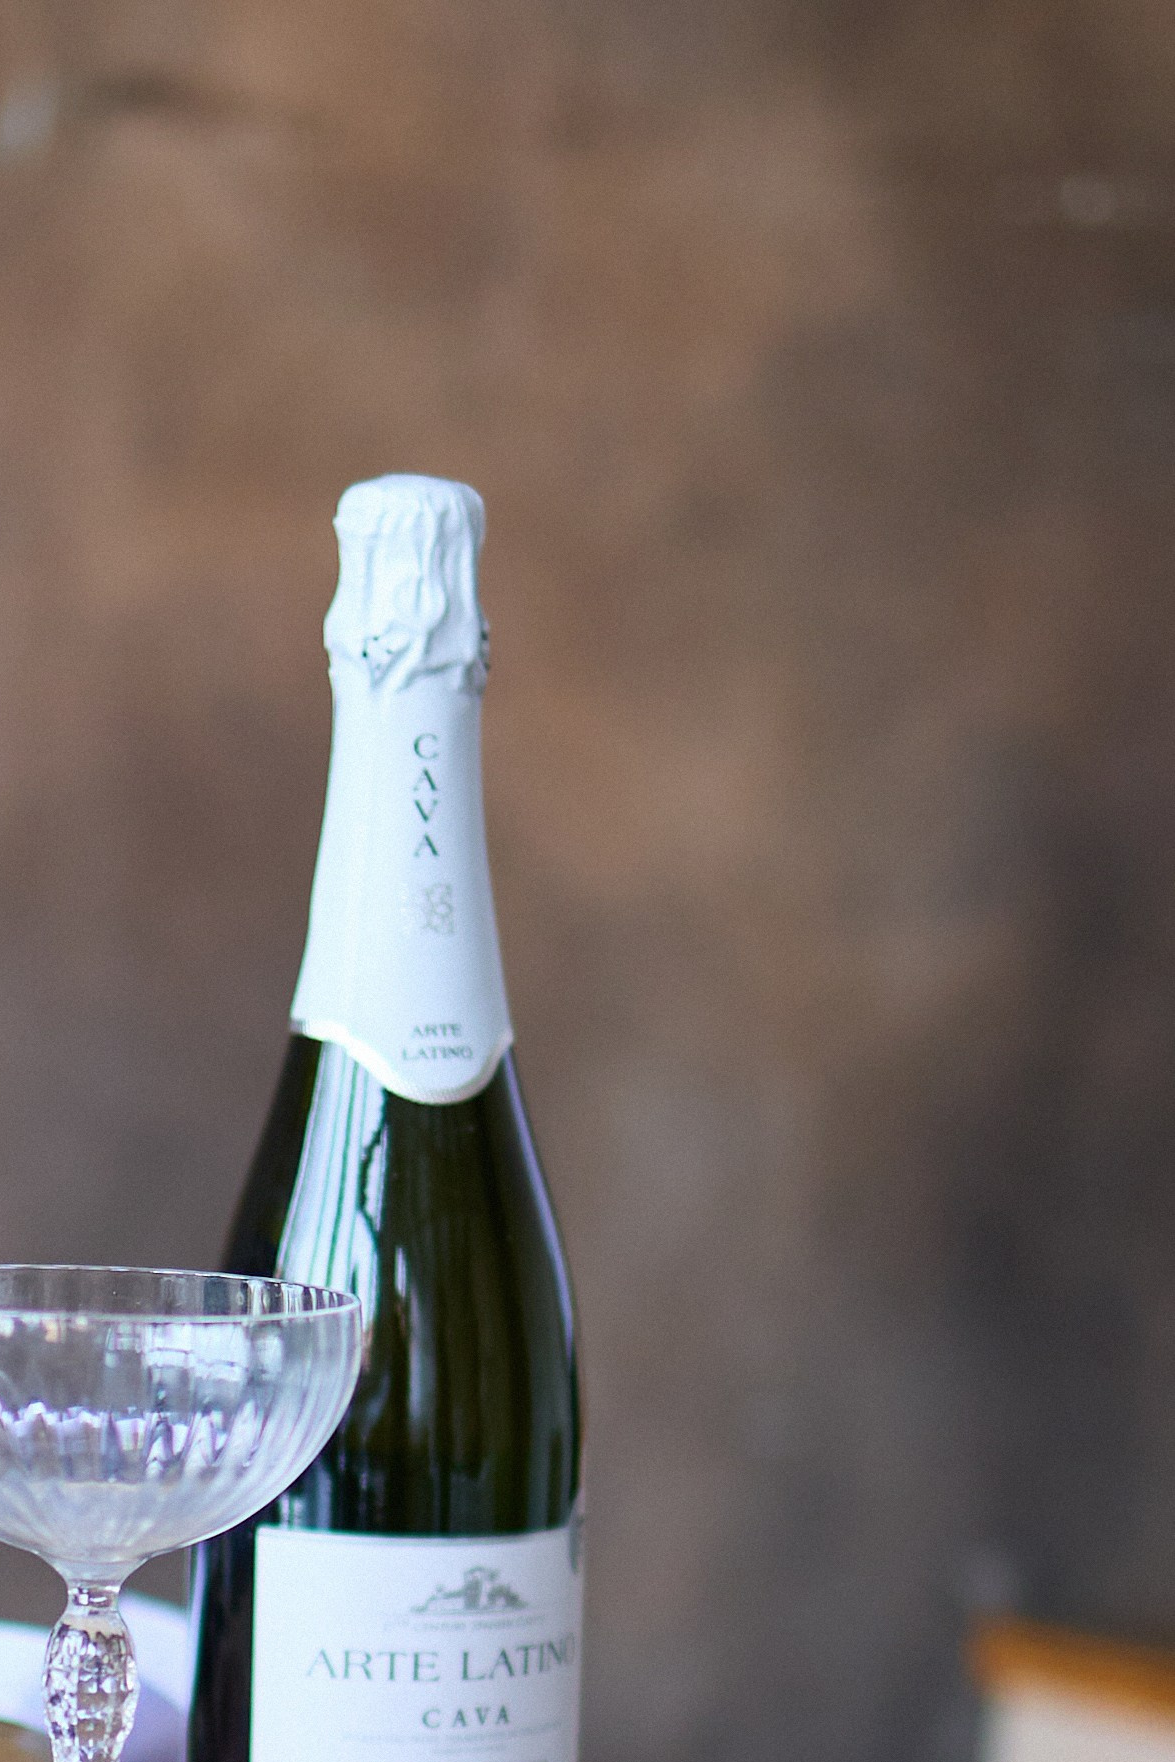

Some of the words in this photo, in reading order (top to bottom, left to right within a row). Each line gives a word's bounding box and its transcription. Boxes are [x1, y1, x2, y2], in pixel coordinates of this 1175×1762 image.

[413, 732, 441, 858] CAVA
[410, 1023, 462, 1038] ARTE
[401, 1044, 474, 1061] LATINO
[305, 1647, 441, 1682] ARTE
[421, 1704, 511, 1729] CAVA
